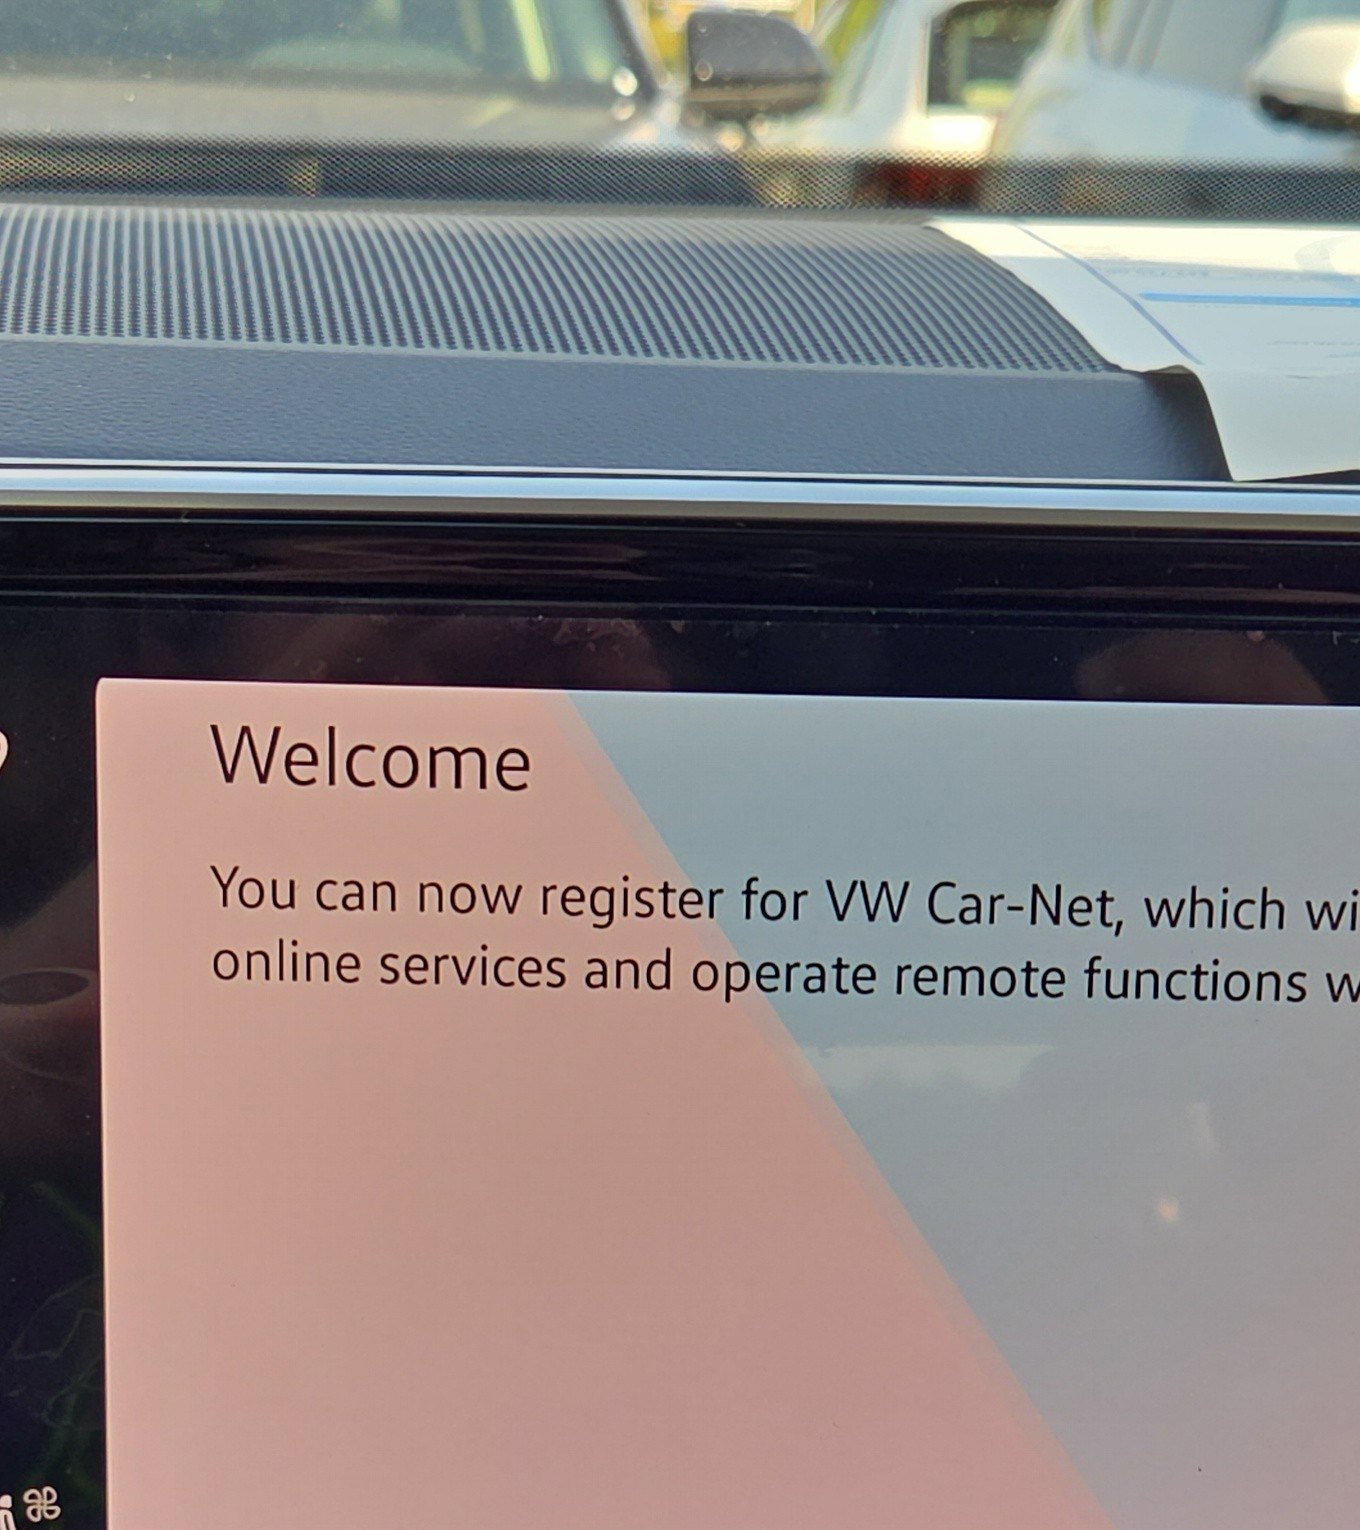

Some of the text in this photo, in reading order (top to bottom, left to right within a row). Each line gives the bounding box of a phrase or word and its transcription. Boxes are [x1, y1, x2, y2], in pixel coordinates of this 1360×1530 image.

[209, 723, 531, 792] Welcome
[210, 865, 295, 909] You
[316, 880, 396, 912] can
[420, 882, 522, 914] now
[543, 875, 724, 929] register
[742, 877, 808, 921] for
[826, 880, 909, 922] VW
[928, 881, 1123, 937] Car-Net,
[1144, 885, 1284, 930] which
[213, 938, 360, 983] online
[380, 944, 566, 988] services
[585, 947, 671, 990] and
[693, 955, 877, 1003] operate
[896, 961, 1065, 998] remote
[1084, 956, 1307, 1002] functions
